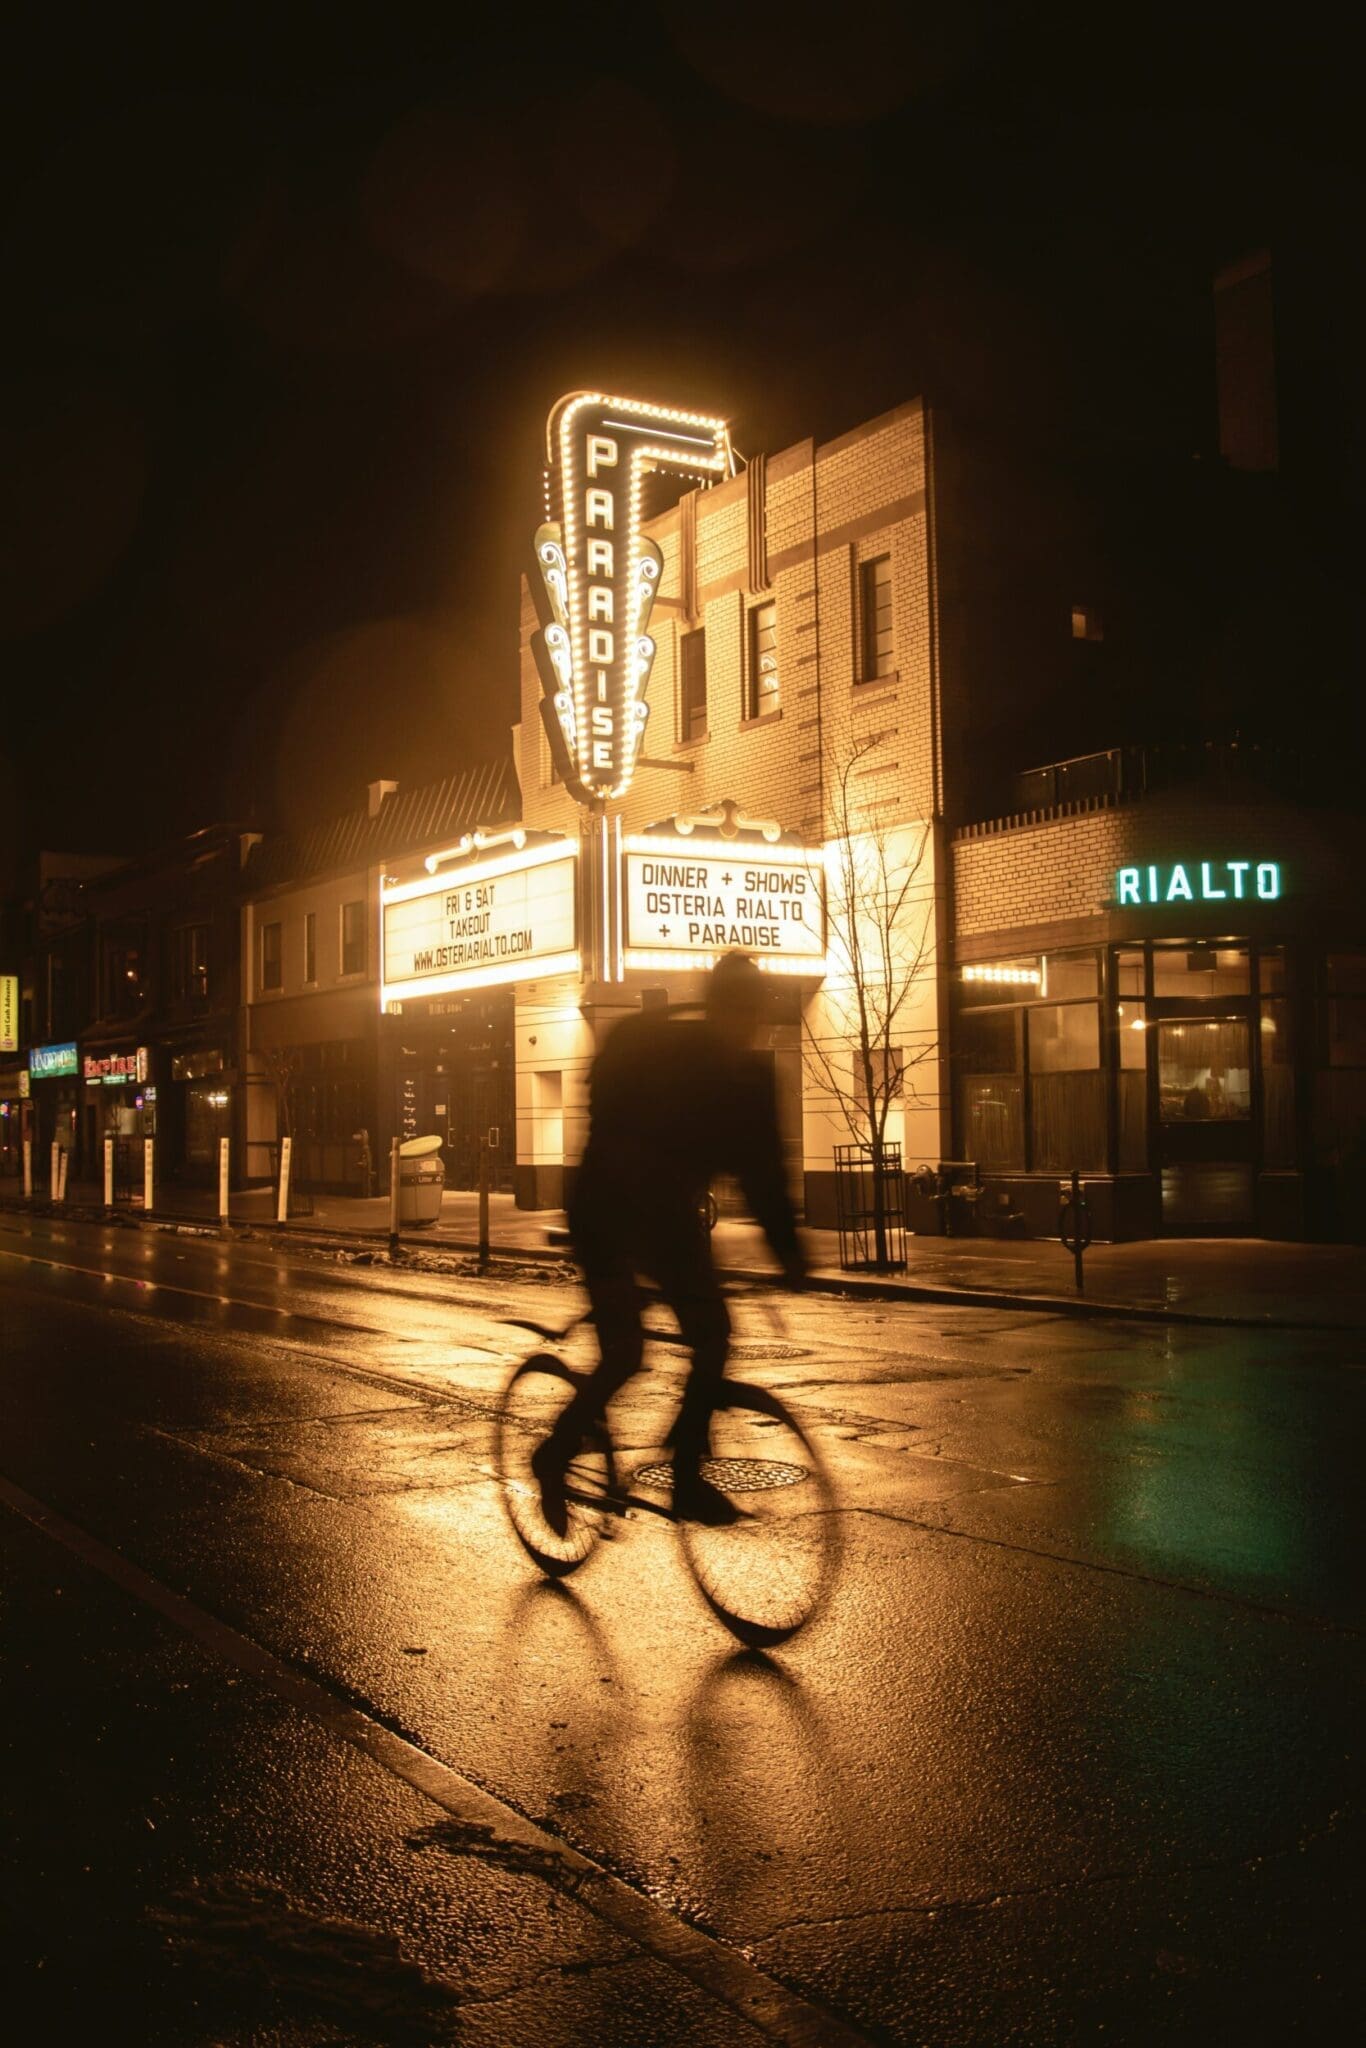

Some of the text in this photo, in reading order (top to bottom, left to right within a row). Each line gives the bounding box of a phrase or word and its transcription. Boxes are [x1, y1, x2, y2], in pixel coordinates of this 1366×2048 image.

[586, 434, 618, 769] PARADISE
[642, 863, 807, 894] DINNER + SHOWS
[1118, 862, 1281, 905] RIALTO
[446, 885, 495, 915] FRI & SAT
[646, 892, 803, 921] OSTERIA RIALTO
[449, 912, 491, 940] TAKEOUT
[659, 922, 781, 947] + PARADISE
[414, 929, 533, 972] WWW.OSTERIARIALTO.COM
